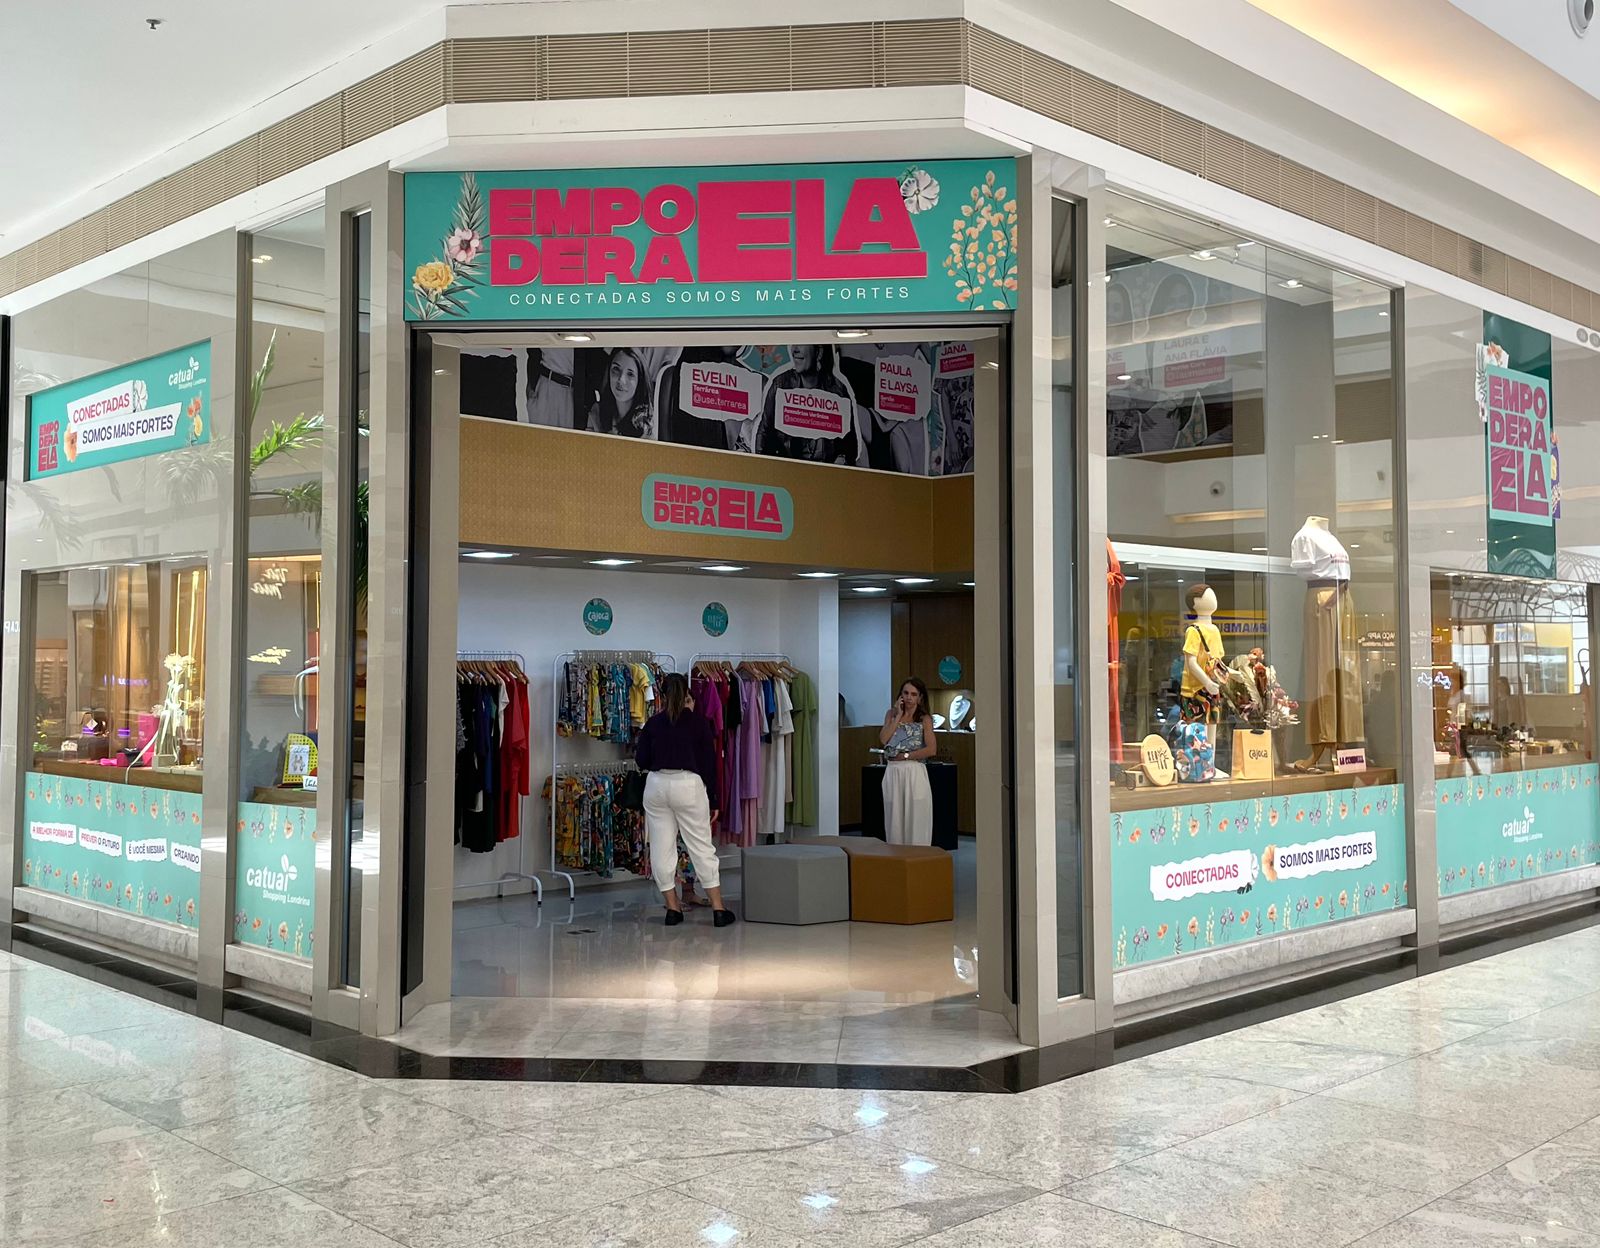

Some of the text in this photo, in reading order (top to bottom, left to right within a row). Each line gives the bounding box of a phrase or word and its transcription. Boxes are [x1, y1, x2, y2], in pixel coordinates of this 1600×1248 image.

[489, 184, 698, 237] EMPO
[697, 177, 928, 282] ELA
[489, 236, 695, 287] DERA
[509, 286, 909, 305] CONECTADAS SOMOS MAIS FORTES
[942, 343, 967, 356] JANA
[1164, 352, 1188, 362] ANA
[692, 368, 737, 388] EVELIN
[880, 362, 912, 377] PAULA
[880, 378, 919, 395] E LAYSA
[1488, 375, 1548, 420] EMPO
[73, 393, 130, 424] CONECTADAS
[784, 392, 840, 412] VERÔNICA
[82, 414, 174, 445] SOMOS MAIS FORTES
[1489, 410, 1548, 453] DERA
[654, 481, 719, 507] EMPO
[1490, 445, 1550, 517] ELA
[654, 502, 717, 527] DERA
[719, 487, 783, 533] ELA
[102, 838, 120, 850] FUTURO
[132, 844, 146, 854] VOCÊ
[146, 845, 165, 854] MESMA
[174, 848, 200, 864] CRIANDO
[1280, 841, 1373, 869] SOMOS MAIS FORTES
[1166, 863, 1239, 889] CONECTADAS
